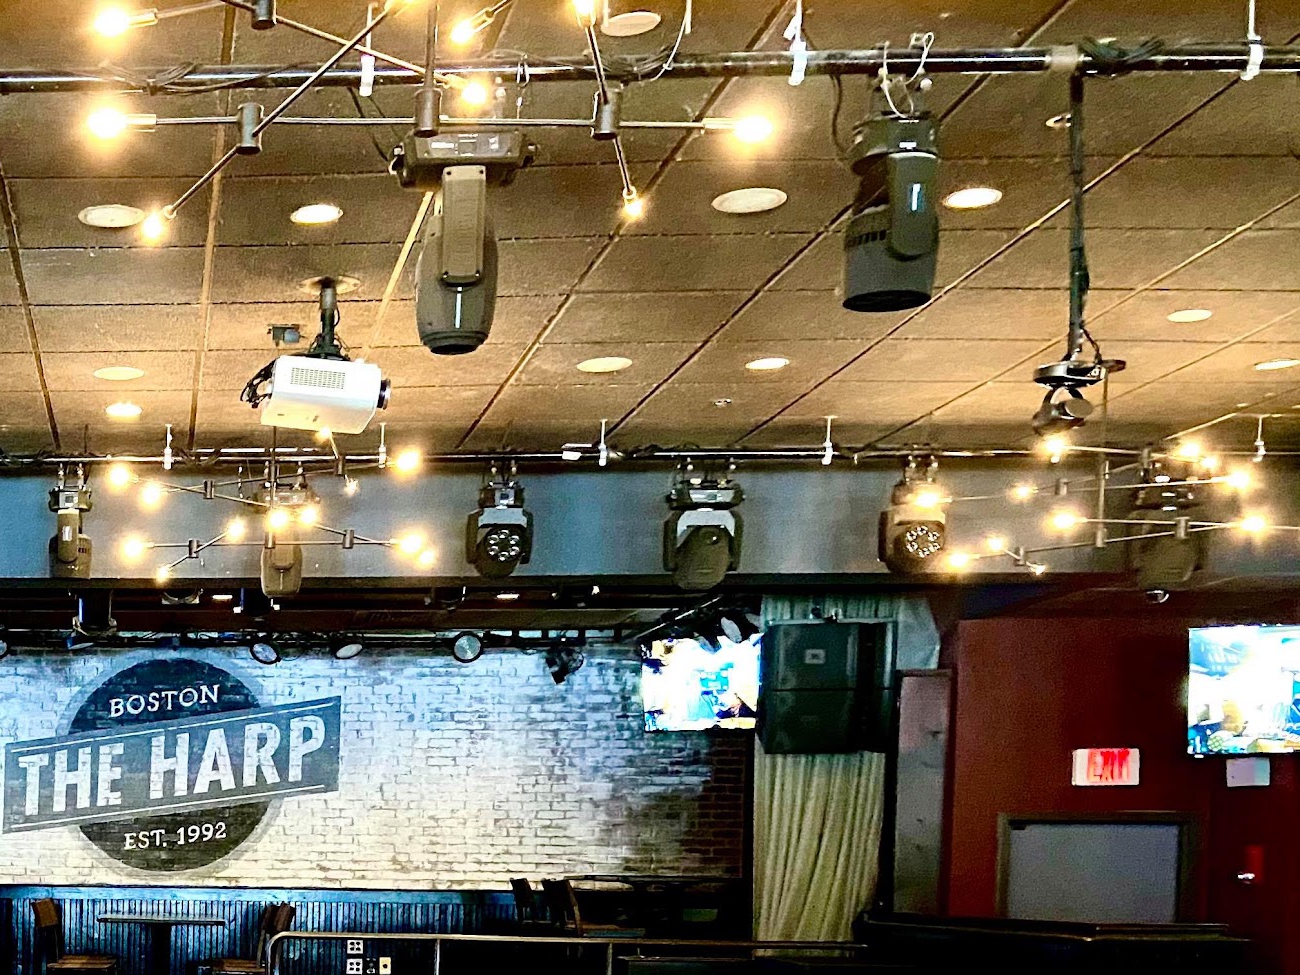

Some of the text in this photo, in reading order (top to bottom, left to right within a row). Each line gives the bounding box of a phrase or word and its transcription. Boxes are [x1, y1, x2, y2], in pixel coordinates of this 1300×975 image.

[109, 684, 220, 718] BOSTON
[18, 715, 326, 816] THE HARP
[1087, 749, 1130, 782] EXIT
[123, 822, 228, 851] EST. 1992
